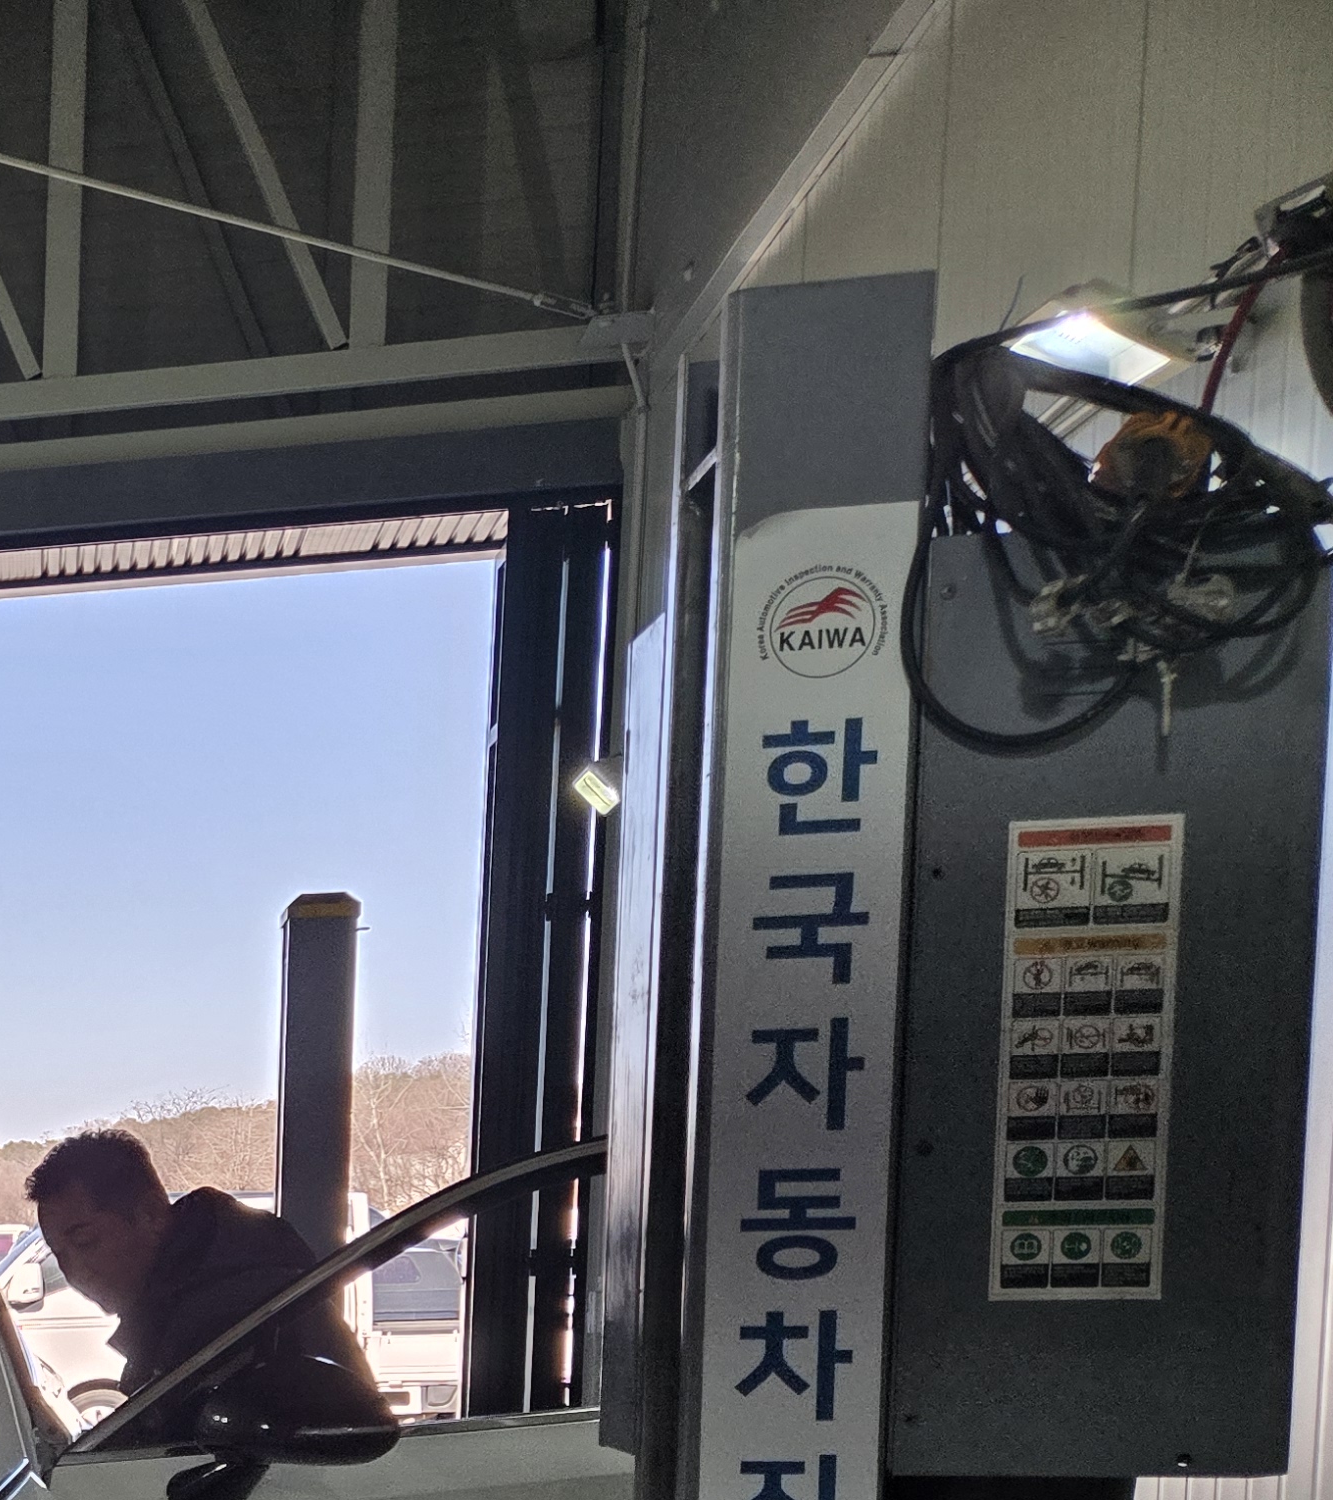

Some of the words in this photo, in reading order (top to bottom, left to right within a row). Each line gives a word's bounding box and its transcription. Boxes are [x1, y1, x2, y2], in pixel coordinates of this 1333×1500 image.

[785, 564, 833, 586] Inspection
[835, 565, 853, 575] and
[854, 570, 884, 602] Warranty
[757, 584, 786, 631] Automotive
[779, 627, 866, 652] KAIWA
[872, 604, 889, 656] Association
[757, 635, 770, 661] Korea
